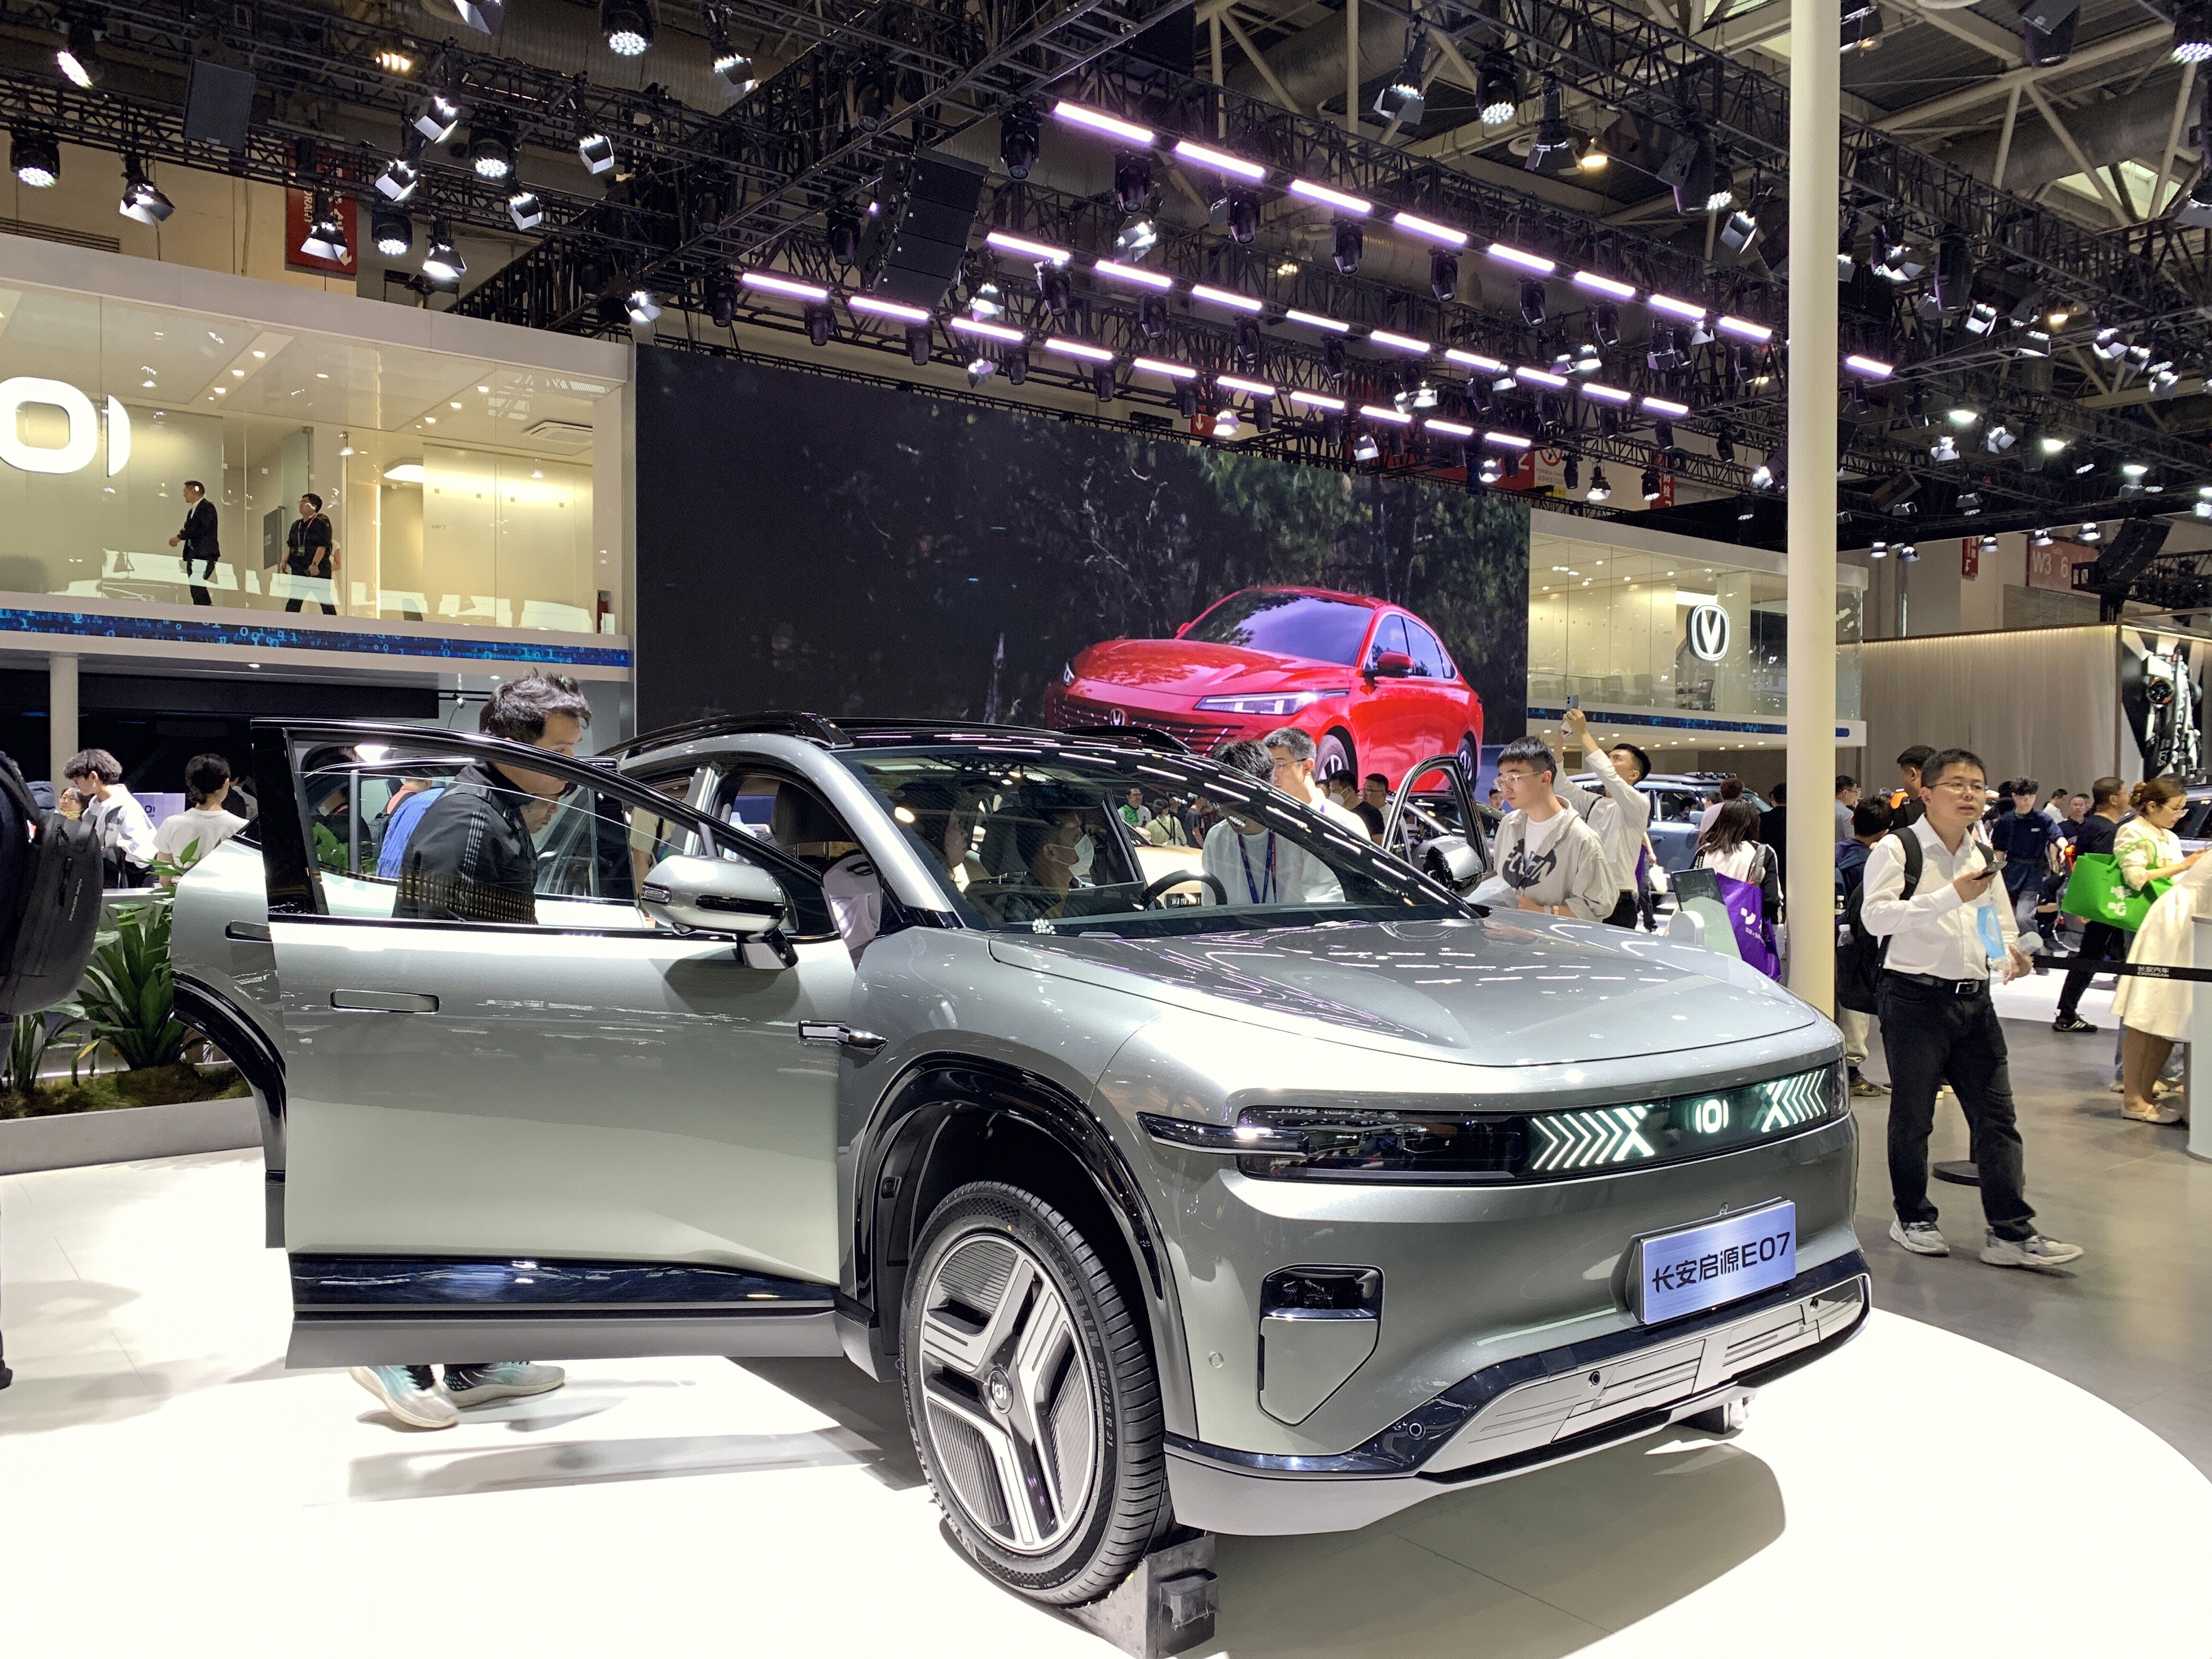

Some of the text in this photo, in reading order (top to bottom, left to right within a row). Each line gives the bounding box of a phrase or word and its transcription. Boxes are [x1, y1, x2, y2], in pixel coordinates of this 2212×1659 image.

[2032, 550, 2069, 578] W3 6
[1652, 1232, 1790, 1294] 长安启源E07
